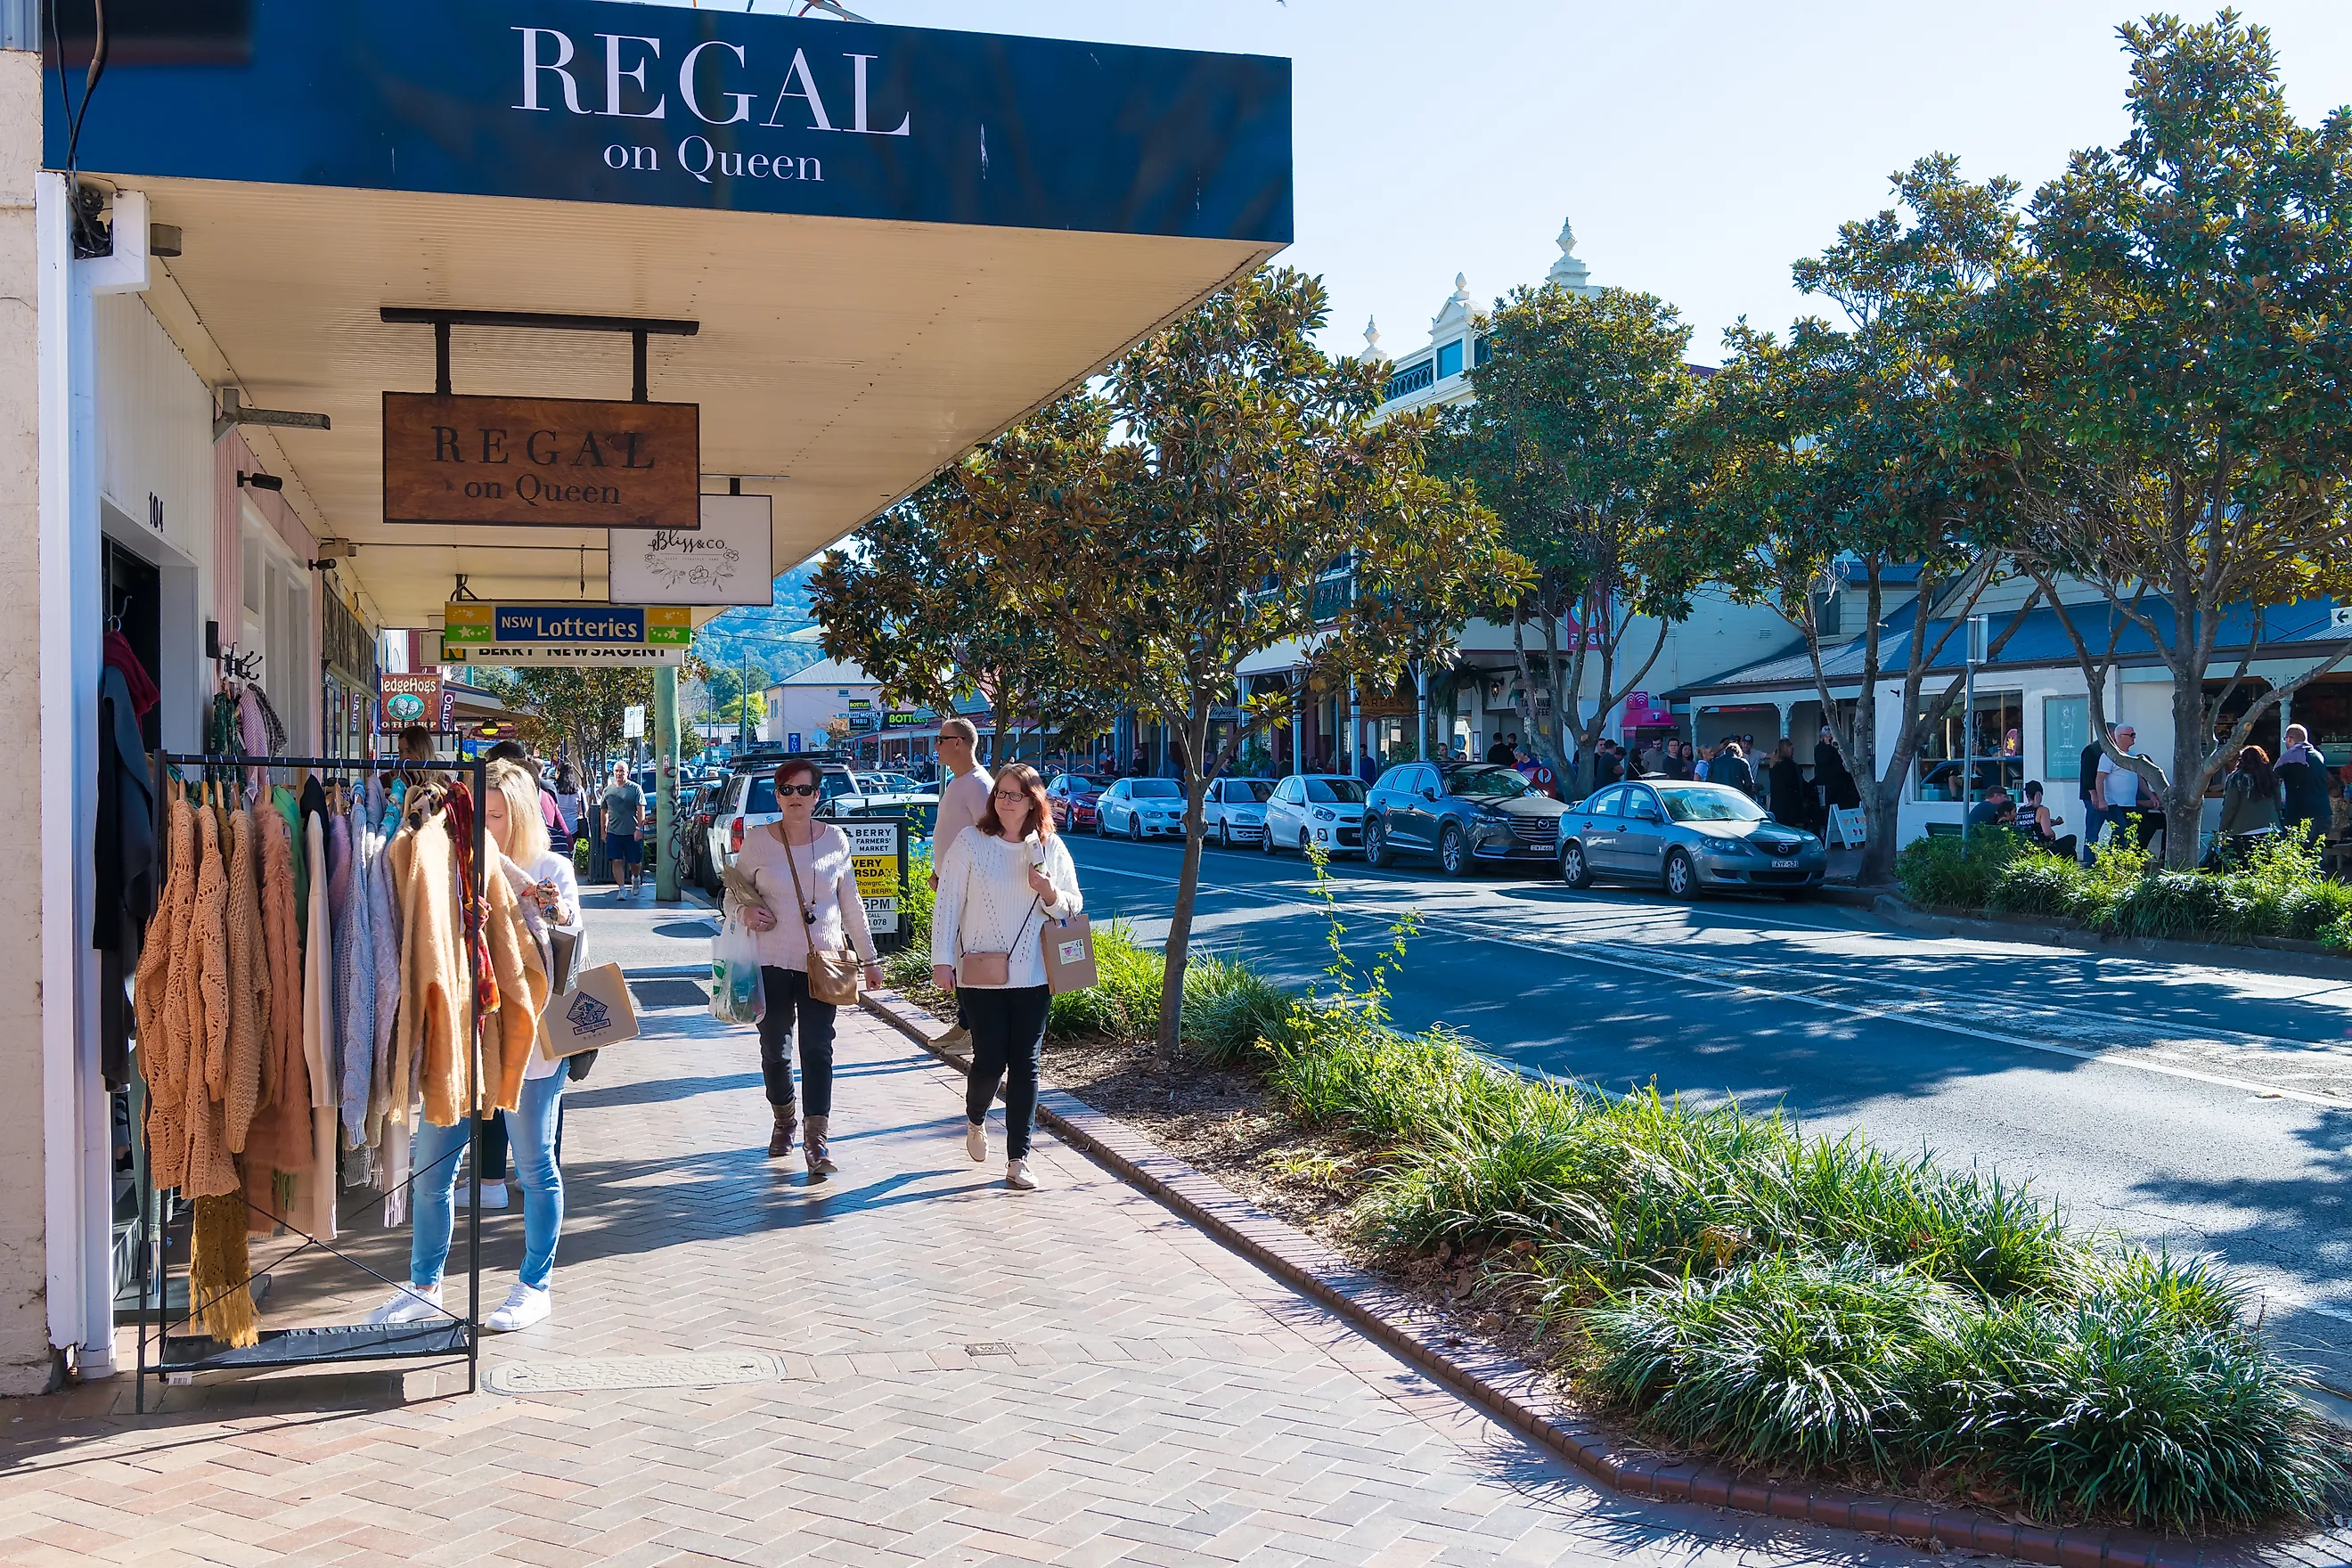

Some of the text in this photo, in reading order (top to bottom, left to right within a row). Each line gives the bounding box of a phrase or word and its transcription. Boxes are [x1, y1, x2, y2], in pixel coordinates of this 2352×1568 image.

[510, 26, 910, 136] REGAL
[602, 135, 825, 184] on Queen
[430, 425, 655, 469] REGAL
[463, 473, 622, 507] on Queen
[149, 491, 164, 534] 104
[501, 616, 638, 639] NSW Lotteries
[1362, 698, 1405, 707] ARDEN
[1525, 707, 1549, 716] CFEE
[855, 829, 892, 837] BERRY
[852, 858, 883, 868] VERY
[853, 868, 894, 878] RSDAY
[873, 919, 887, 927] 078
